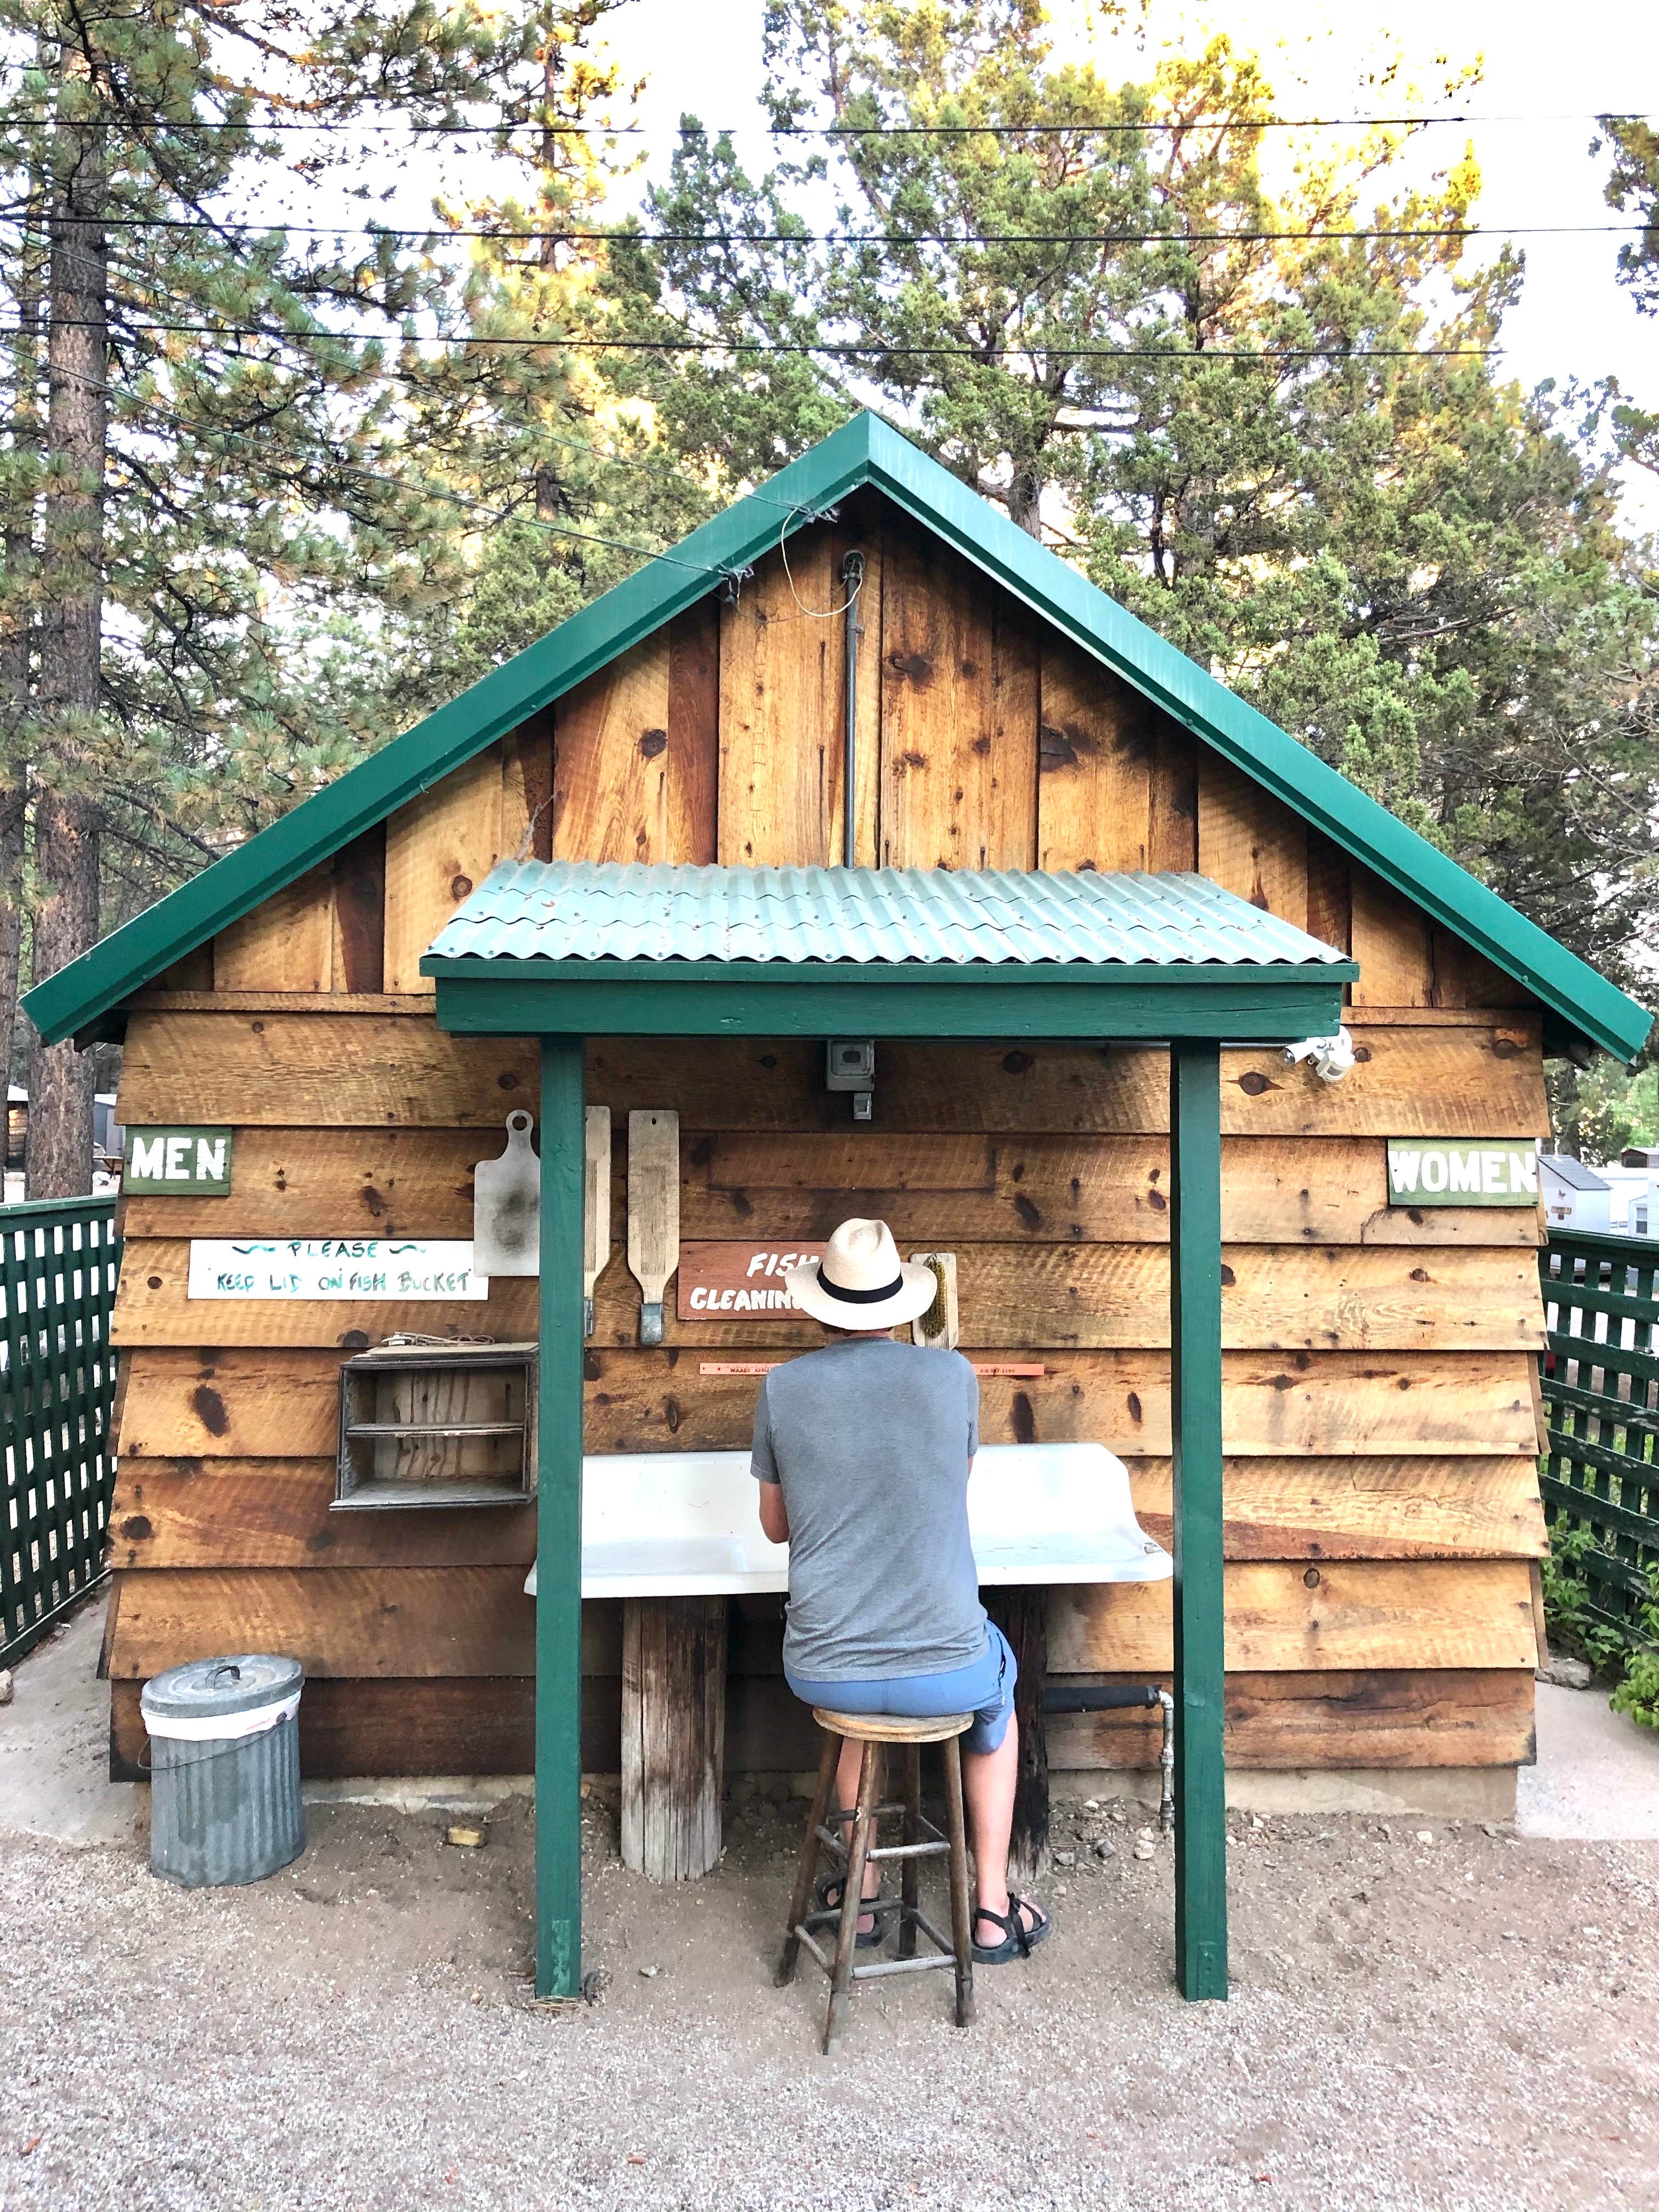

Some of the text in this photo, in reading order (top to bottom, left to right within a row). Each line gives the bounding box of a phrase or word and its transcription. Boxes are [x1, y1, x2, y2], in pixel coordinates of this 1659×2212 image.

[131, 1137, 226, 1180] MEN
[1388, 1150, 1538, 1193] WOMEN
[287, 1240, 379, 1258] PLEASE
[217, 1271, 469, 1294] KEEP LID ON FISH BUCKET
[690, 1287, 802, 1311] CLEANIN
